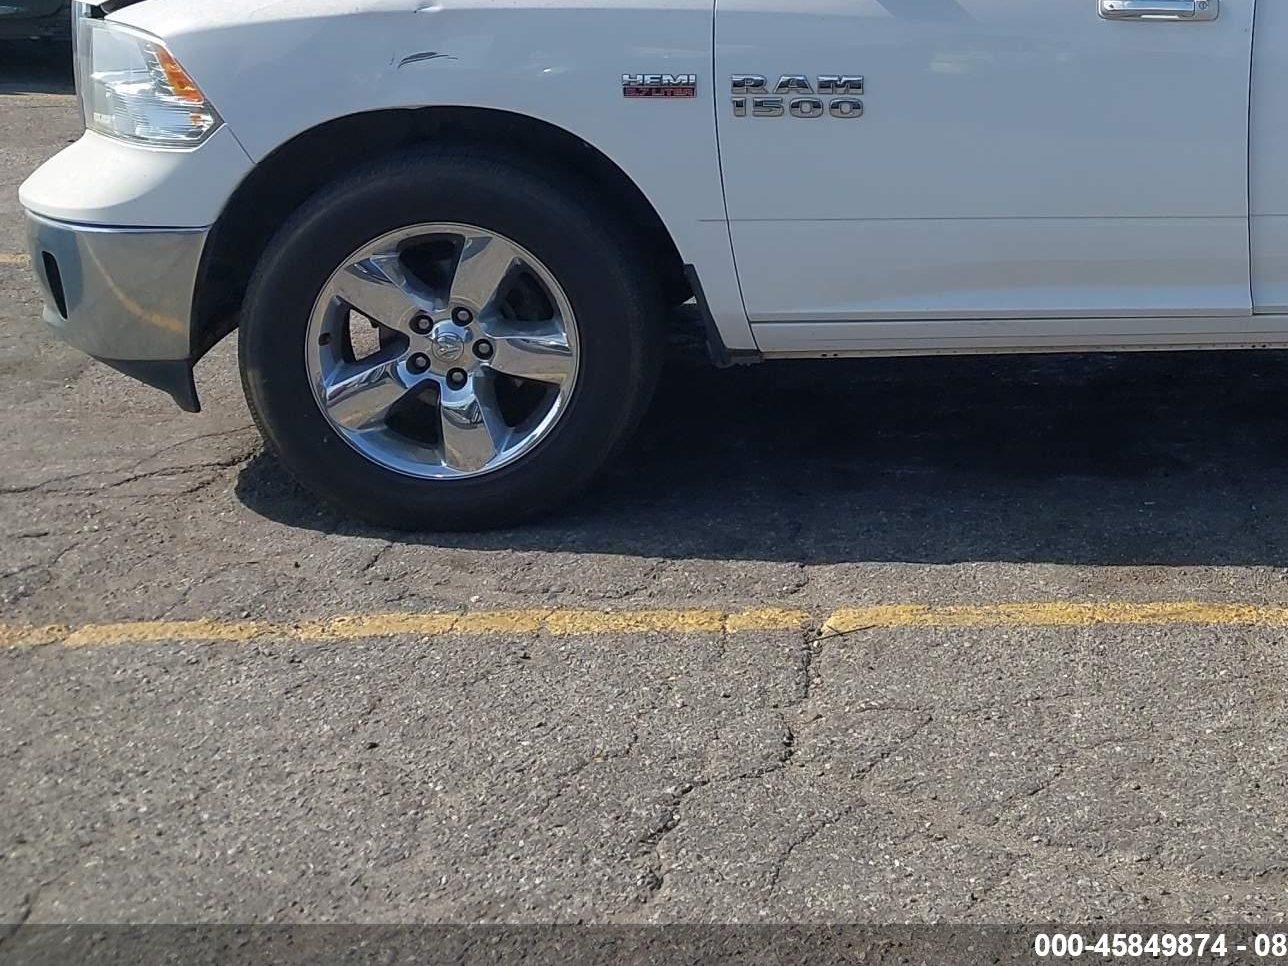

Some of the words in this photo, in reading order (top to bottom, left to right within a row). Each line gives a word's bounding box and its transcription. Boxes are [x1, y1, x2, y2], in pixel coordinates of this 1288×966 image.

[622, 74, 697, 86] HEMI
[730, 74, 864, 95] RAM
[732, 97, 864, 119] 1500
